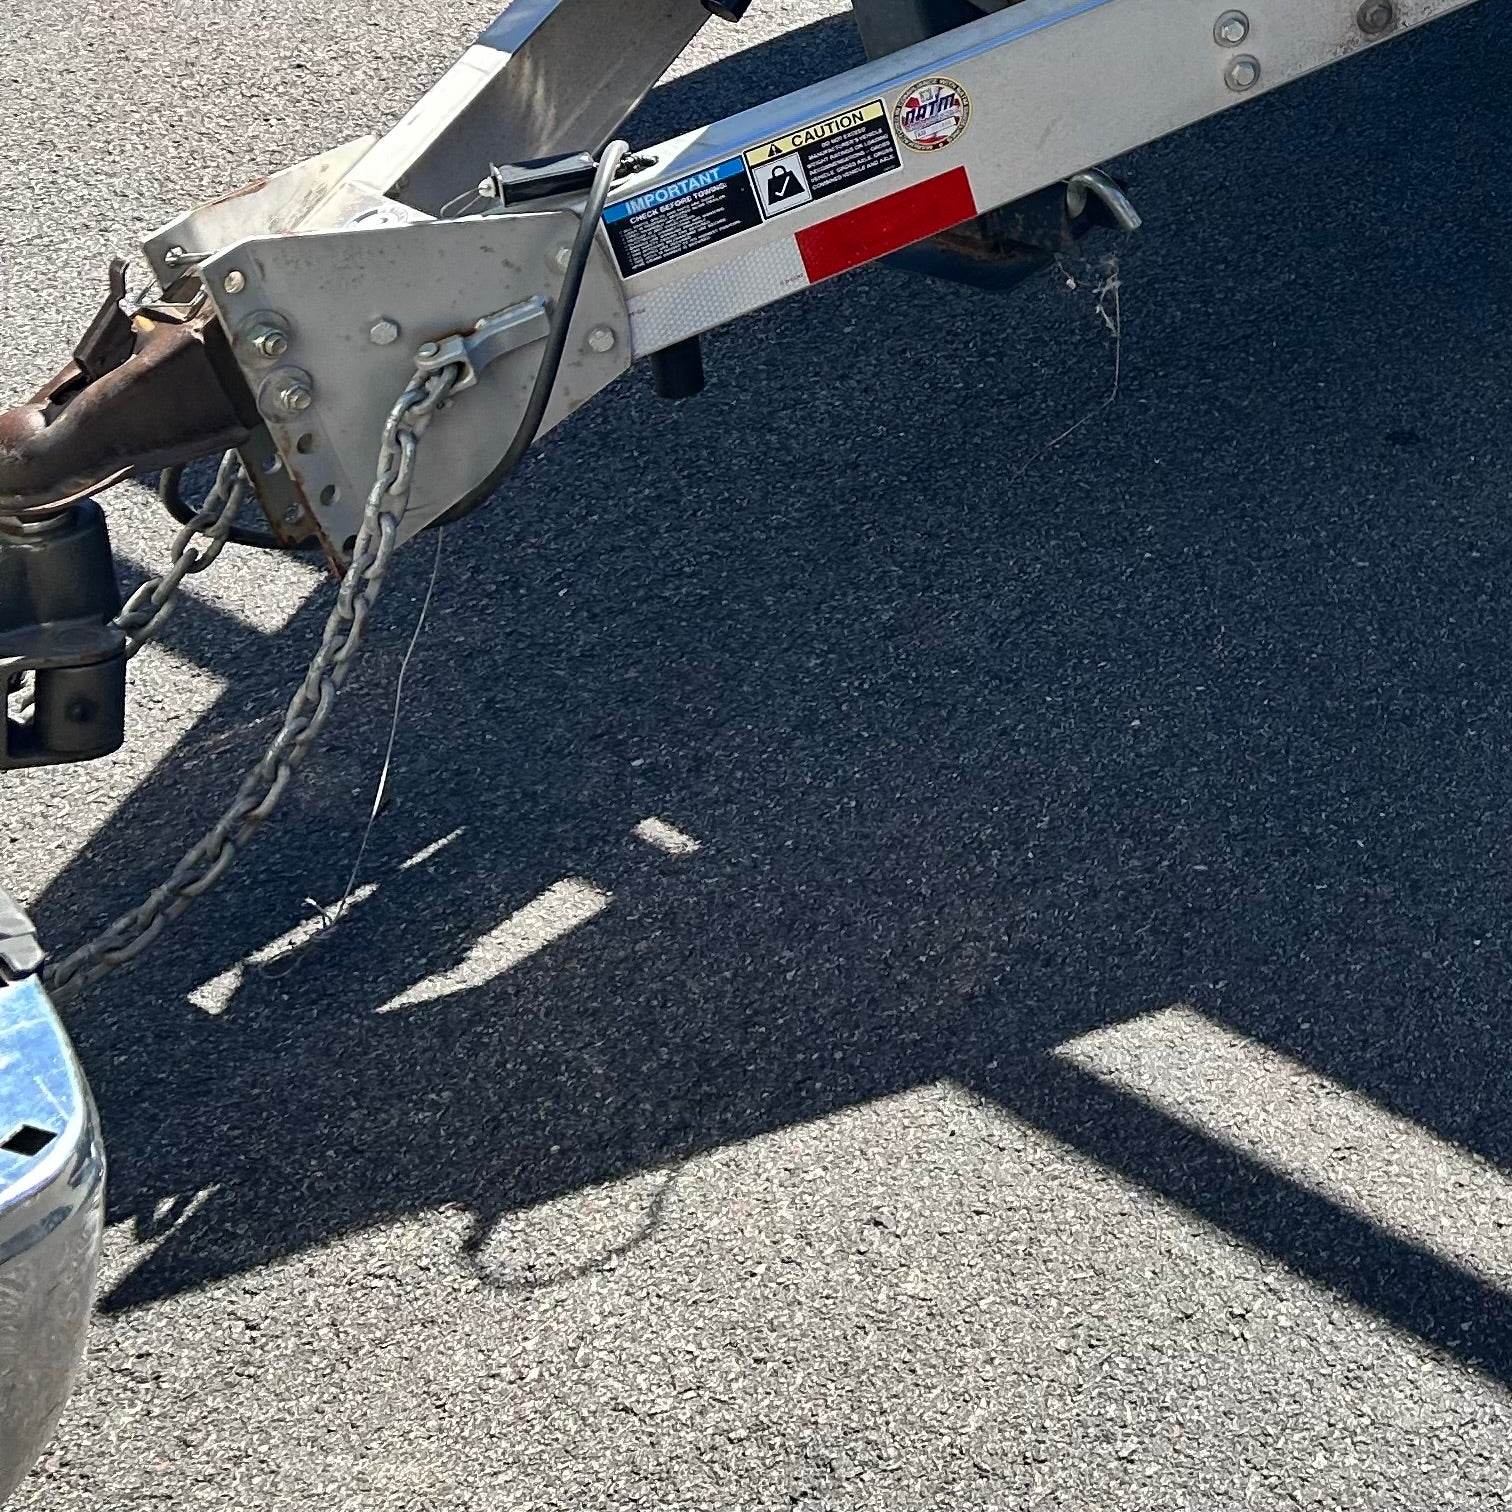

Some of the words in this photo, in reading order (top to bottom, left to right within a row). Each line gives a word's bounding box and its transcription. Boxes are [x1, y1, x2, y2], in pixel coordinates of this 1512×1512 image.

[791, 109, 865, 148] CAUTION
[625, 168, 720, 215] IMPORTANT
[629, 208, 659, 225] CHECK
[659, 195, 693, 213] BEFORE
